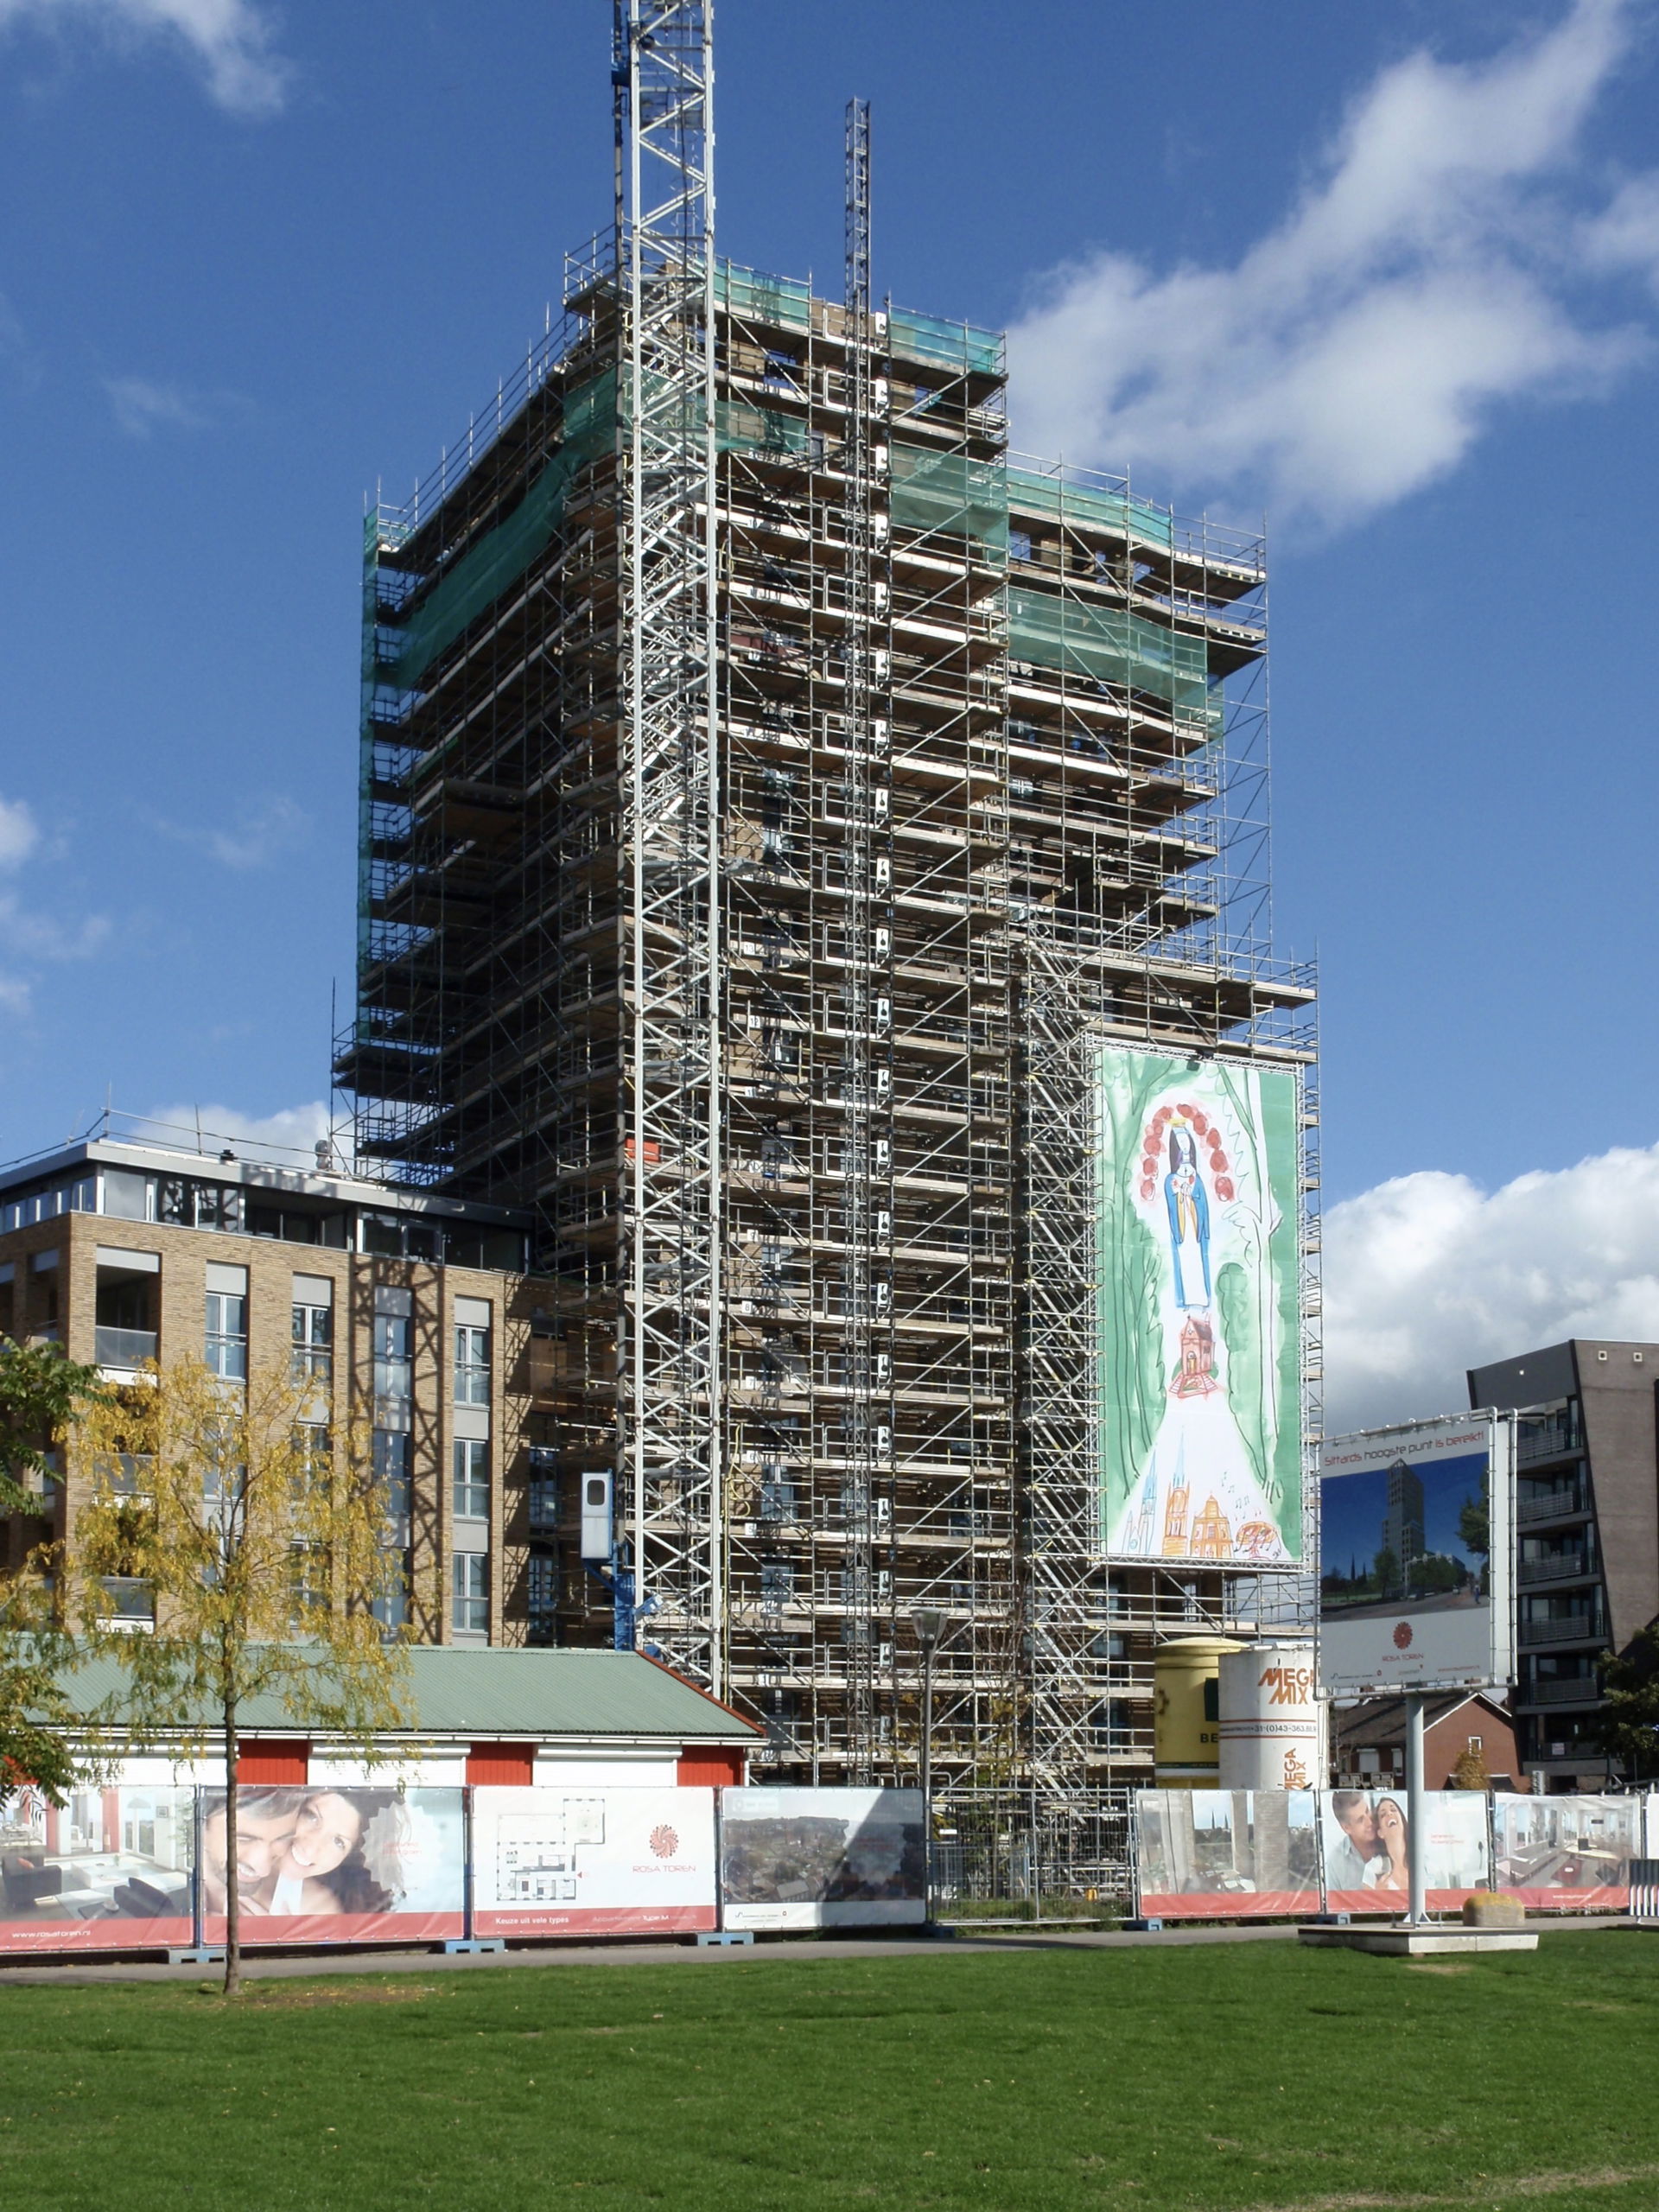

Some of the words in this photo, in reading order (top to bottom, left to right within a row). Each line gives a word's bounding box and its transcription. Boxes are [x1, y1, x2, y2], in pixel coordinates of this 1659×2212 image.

[1325, 1452, 1362, 1466] Sittards
[1363, 1446, 1407, 1460] hoogste
[1408, 1440, 1433, 1454] punt
[1435, 1440, 1444, 1448] is
[1268, 1686, 1308, 1705] MIX
